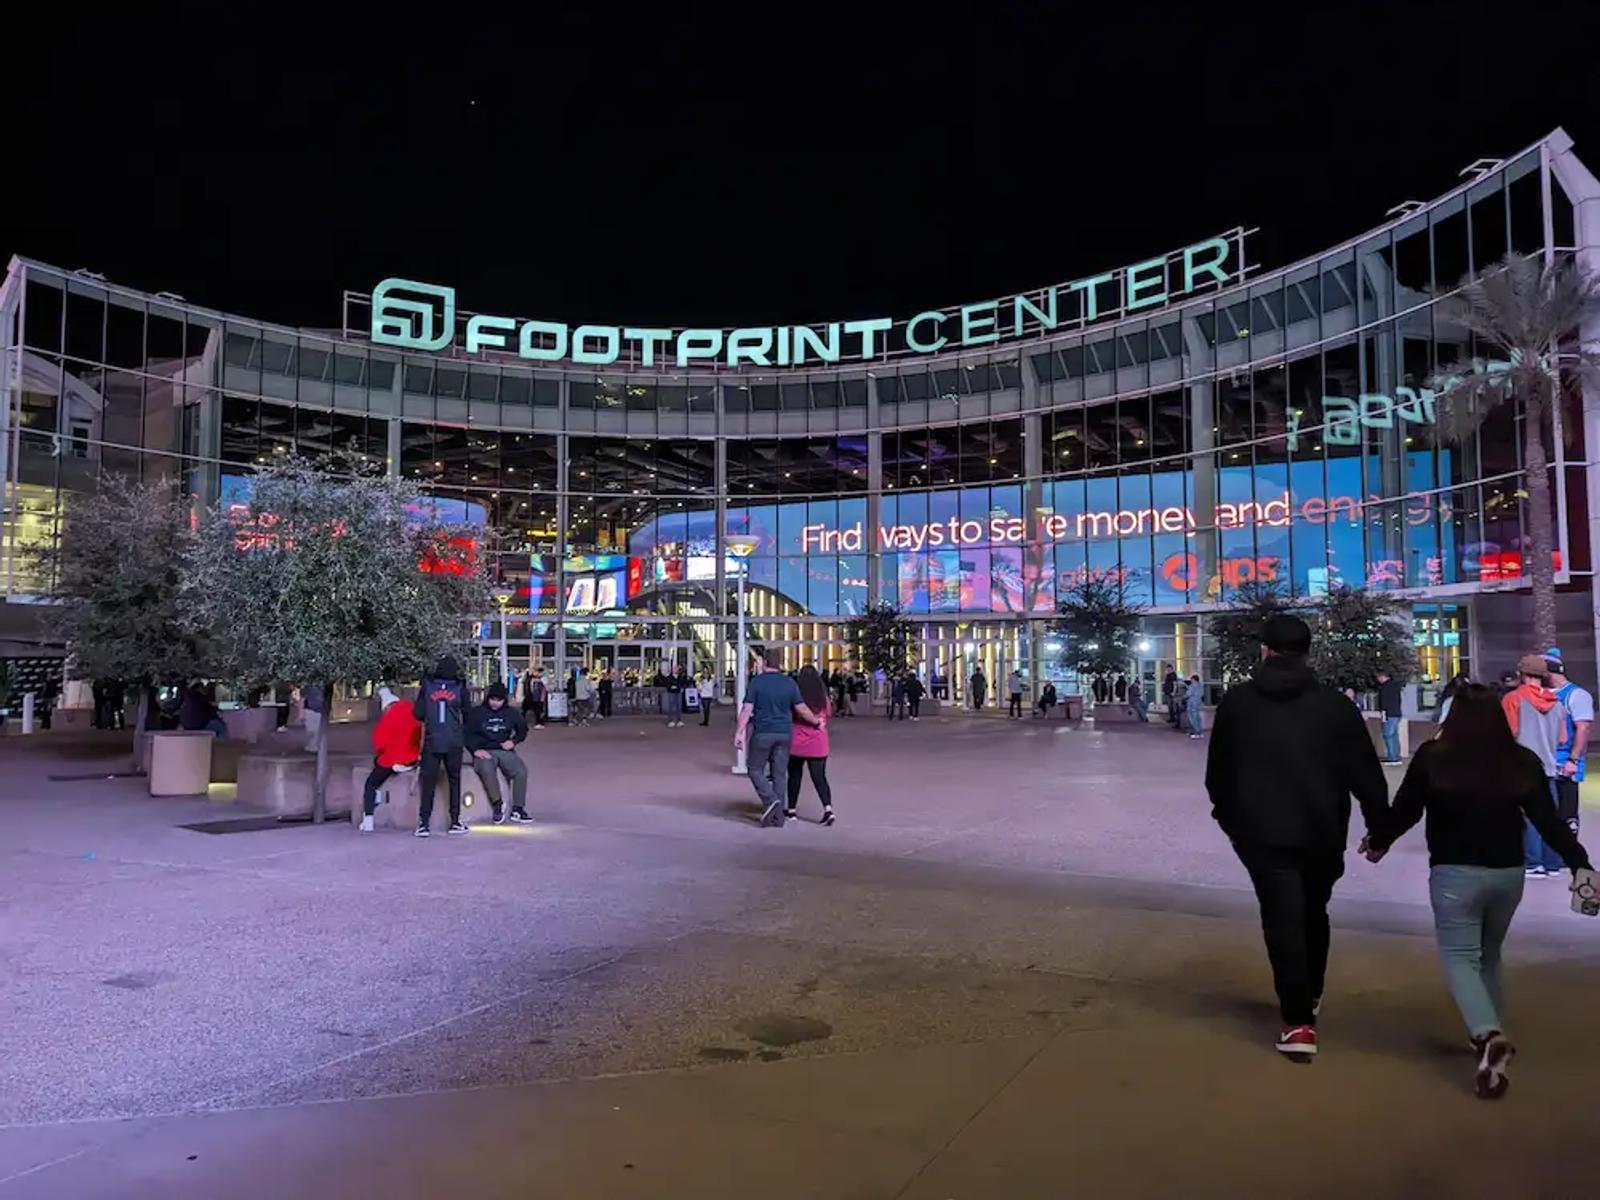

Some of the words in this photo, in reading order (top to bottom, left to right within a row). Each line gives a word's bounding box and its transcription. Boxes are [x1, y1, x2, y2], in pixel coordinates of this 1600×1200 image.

[466, 315, 893, 368] FOOTPRINT
[906, 239, 1230, 353] CENTER
[802, 521, 862, 553] Find
[948, 516, 982, 545] to
[990, 514, 1068, 543] sae
[1214, 491, 1291, 528] and
[439, 701, 446, 723] 1
